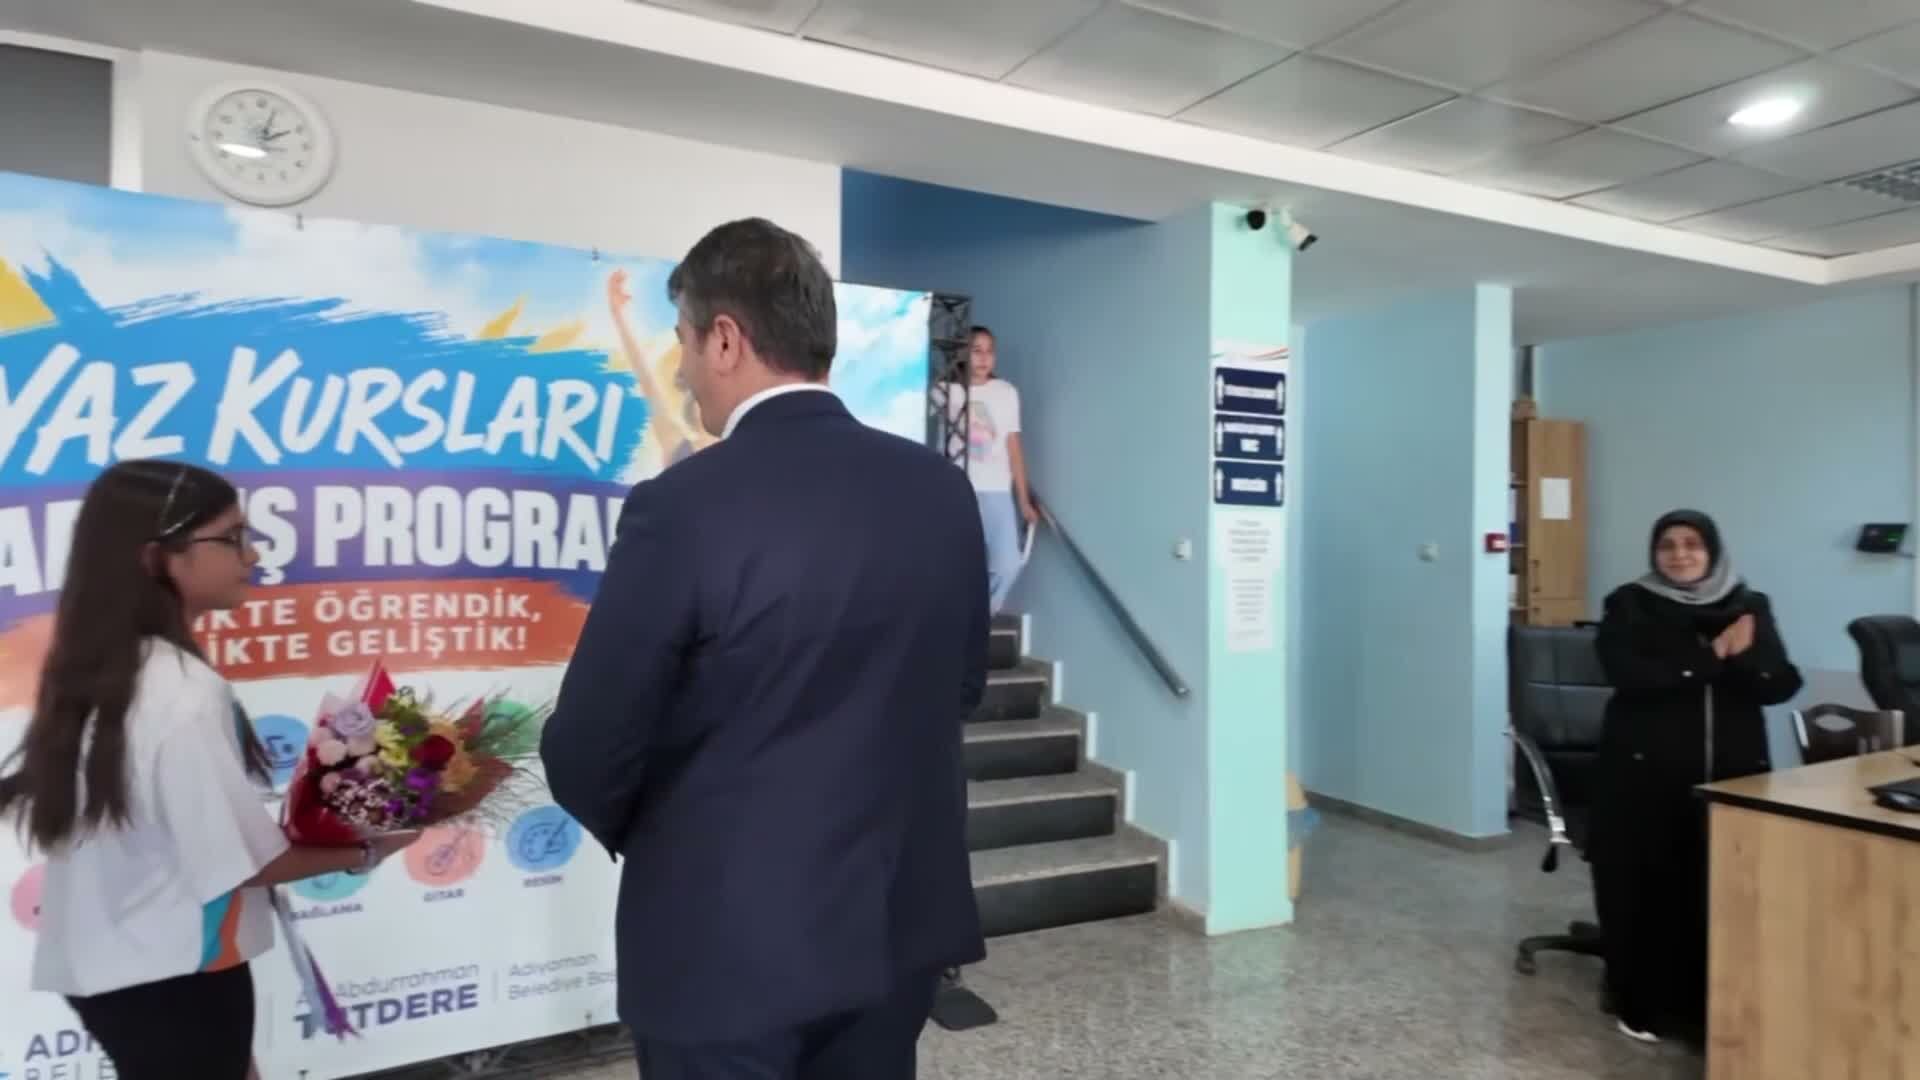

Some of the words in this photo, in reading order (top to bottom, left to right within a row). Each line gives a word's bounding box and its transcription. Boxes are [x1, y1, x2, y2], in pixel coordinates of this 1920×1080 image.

[207, 346, 624, 470] KURSLARI
[313, 485, 625, 572] PROGRA
[327, 620, 527, 659] GELİŞTİK!
